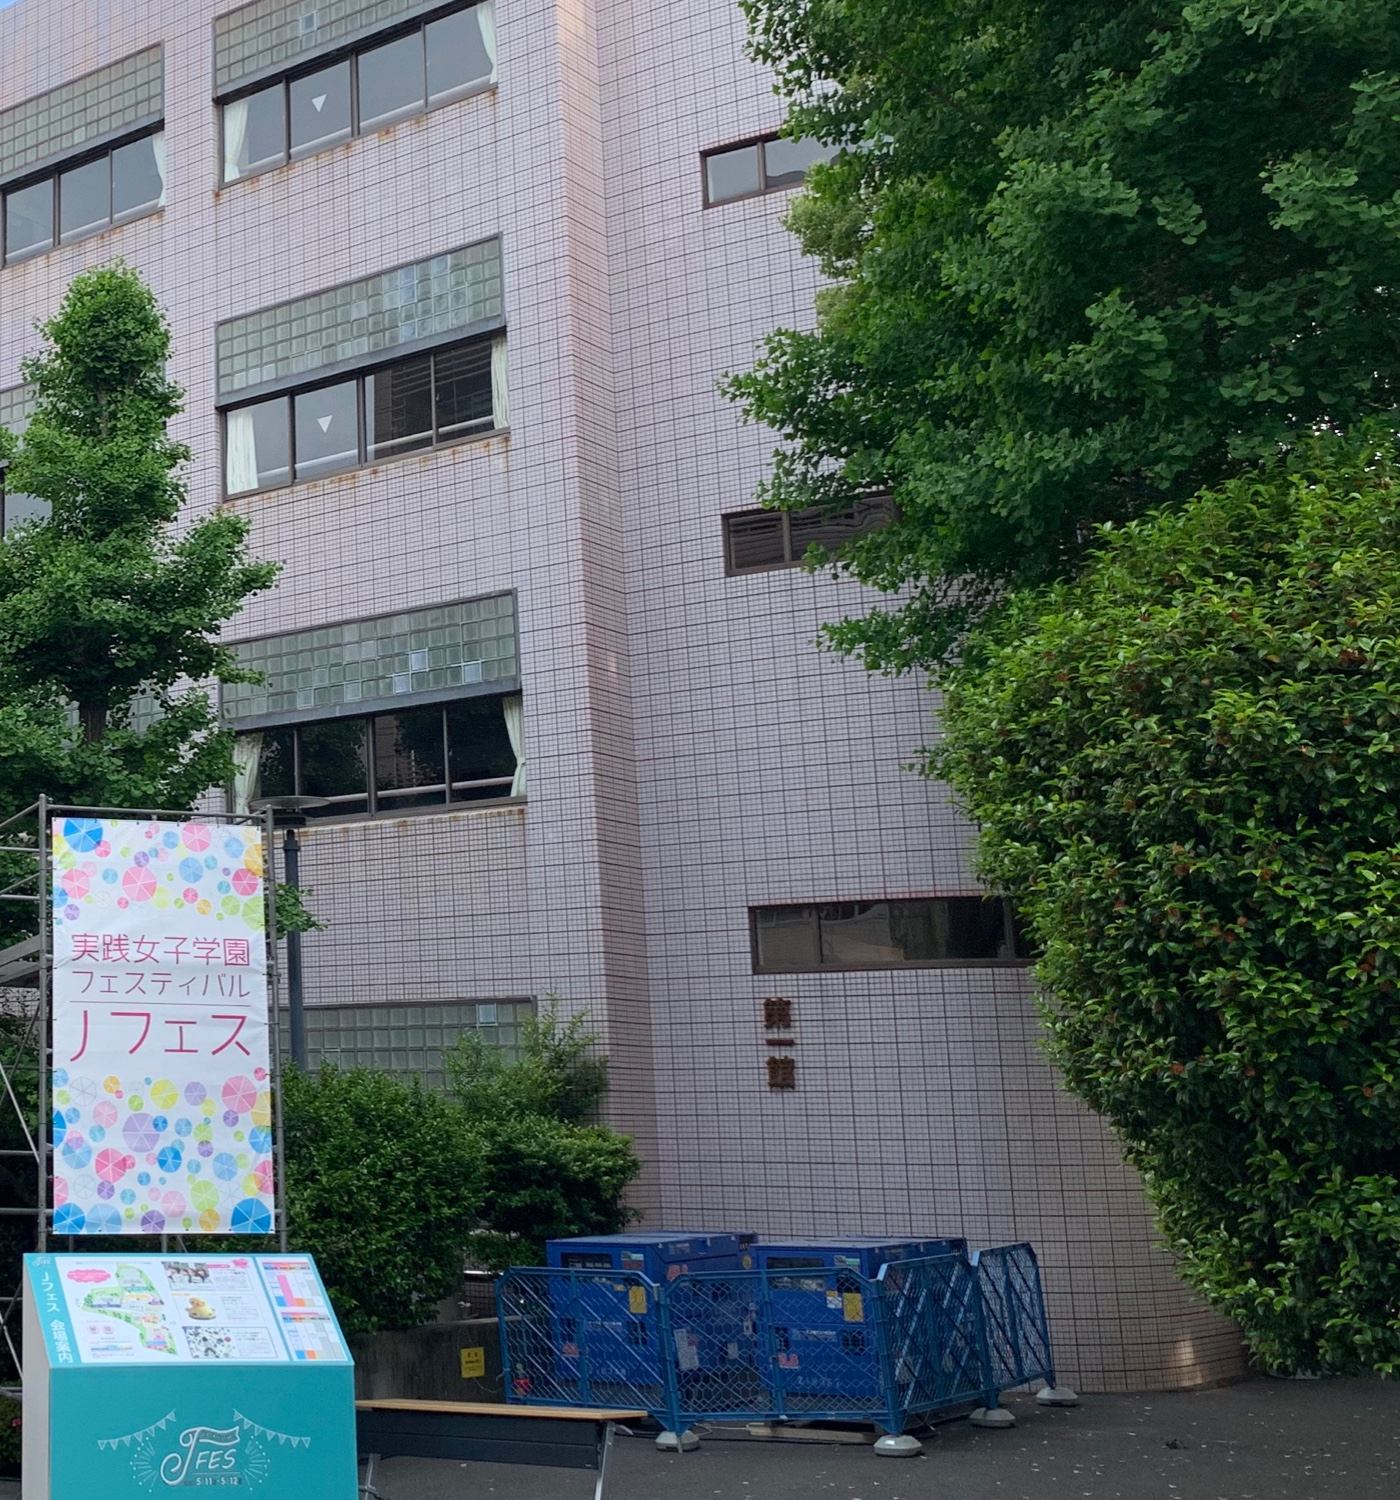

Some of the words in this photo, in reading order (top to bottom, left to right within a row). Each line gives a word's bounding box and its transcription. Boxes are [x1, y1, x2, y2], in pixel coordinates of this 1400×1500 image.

[71, 933, 250, 967] 実践女子学園
[71, 970, 251, 998] フェスティバル
